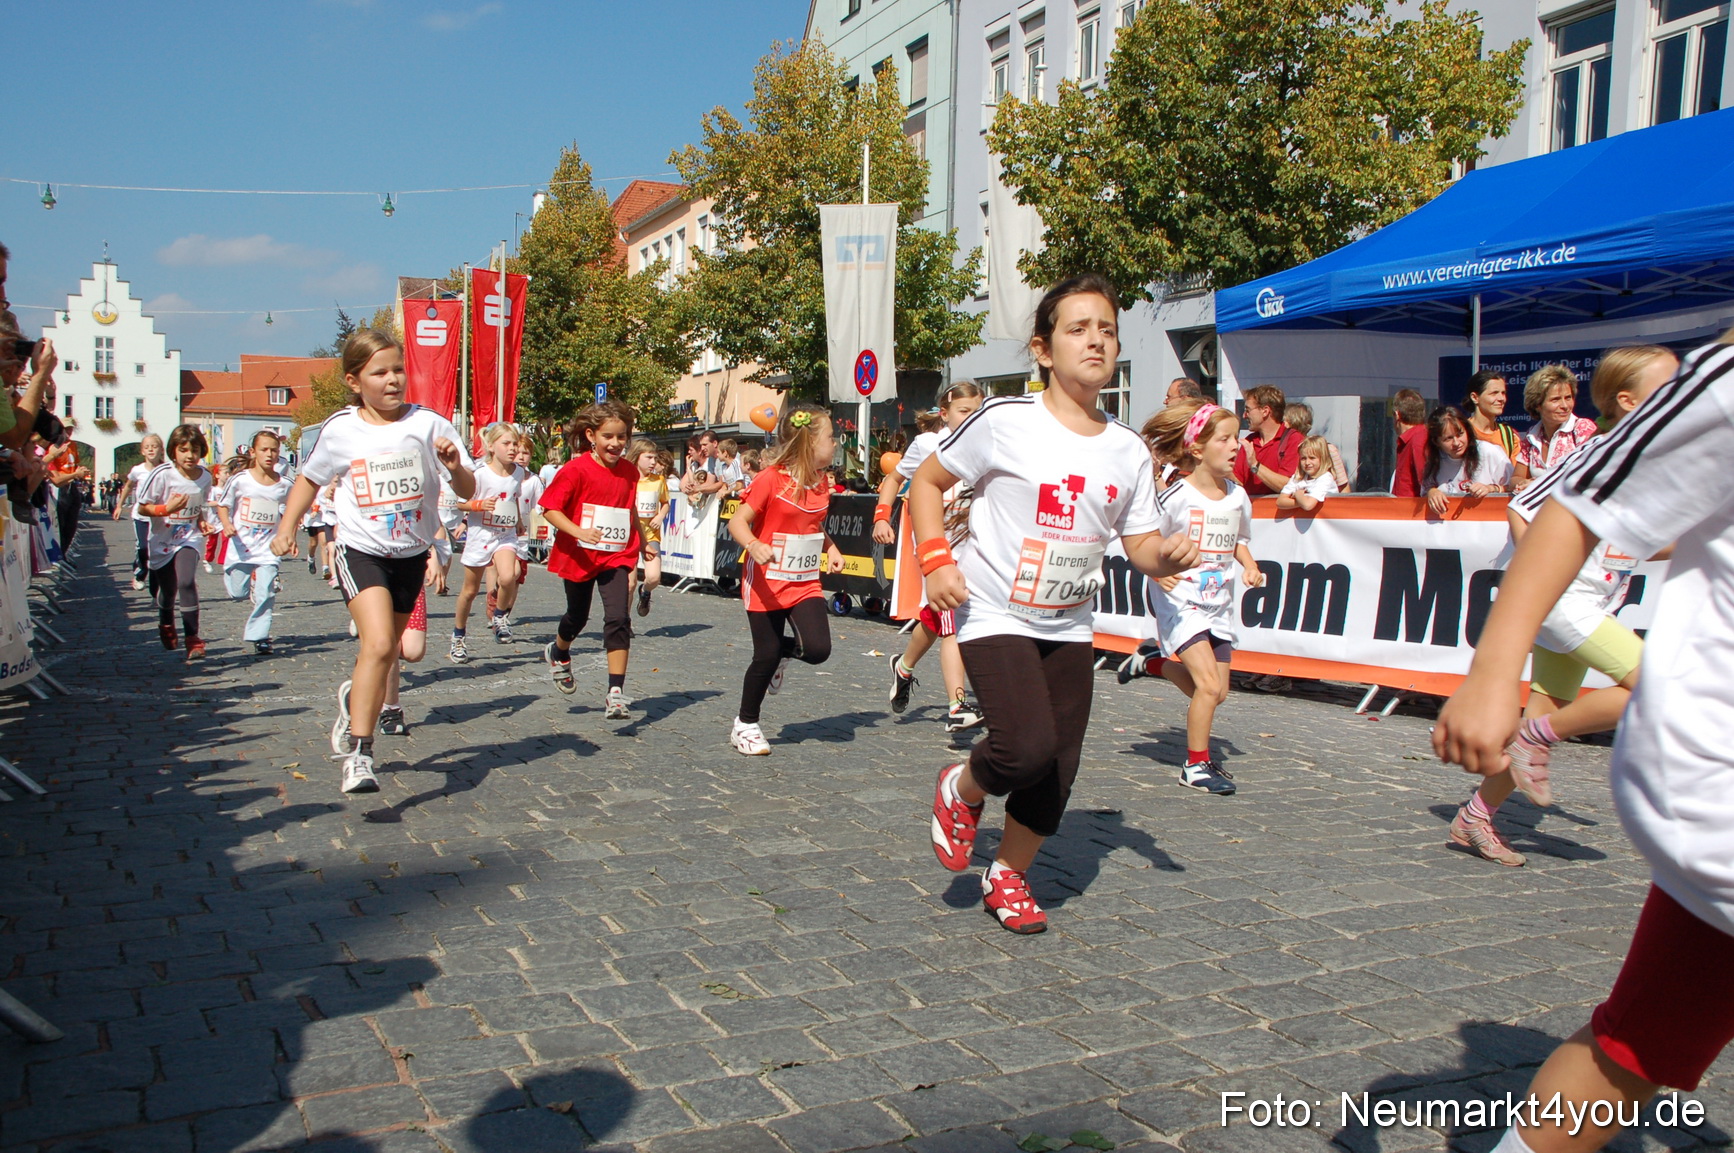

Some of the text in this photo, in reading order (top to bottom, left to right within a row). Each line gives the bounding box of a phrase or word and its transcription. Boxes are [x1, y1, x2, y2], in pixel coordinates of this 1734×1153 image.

[1382, 242, 1577, 290] www.vereinigte-ikk.de
[1560, 357, 1580, 369] Der
[369, 458, 414, 473] Franziska
[356, 476, 420, 498] K3 7053
[250, 511, 274, 521] 7291
[495, 514, 516, 525] 7264
[1038, 511, 1073, 529] DKMS
[1206, 514, 1230, 525] Leonie
[596, 525, 626, 540] 7233
[828, 514, 840, 535] 90
[840, 515, 852, 536] 52
[851, 515, 863, 537] 26
[1041, 531, 1061, 541] JEDER
[1206, 532, 1236, 548] 7098
[787, 554, 818, 568] 7189
[1048, 550, 1089, 568] Lorena
[1020, 569, 1034, 582] K3
[1241, 559, 1351, 636] am
